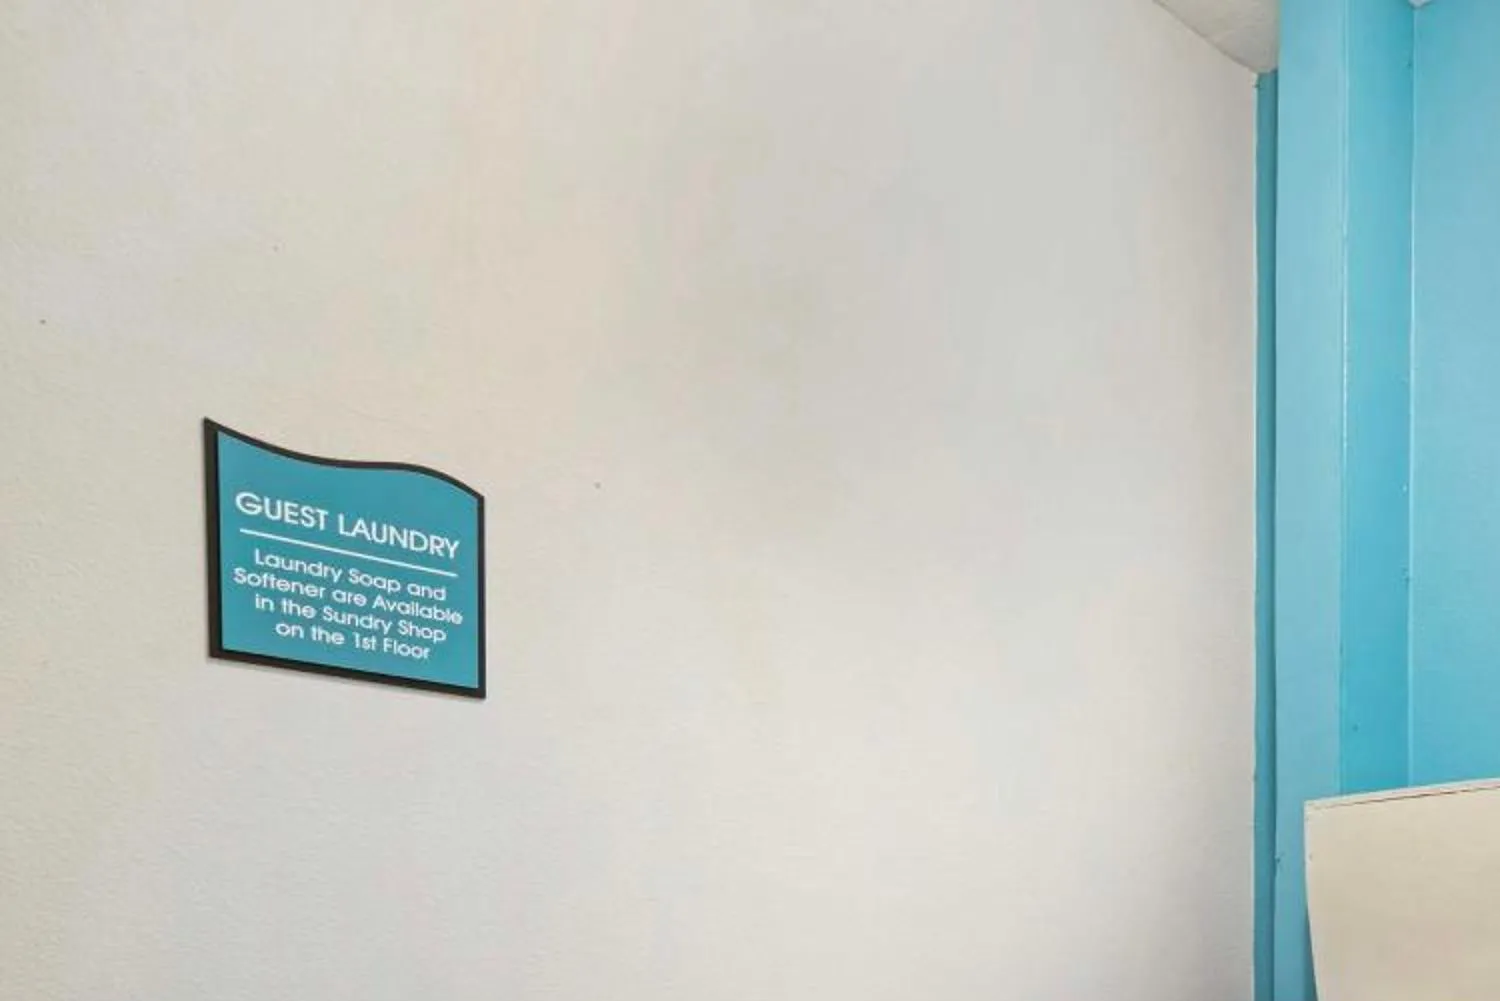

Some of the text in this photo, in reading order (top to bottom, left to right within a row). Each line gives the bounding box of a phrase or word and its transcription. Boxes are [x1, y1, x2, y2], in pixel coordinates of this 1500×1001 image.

[235, 491, 460, 559] GUEST LAUNDRY
[232, 567, 463, 624] Softener are Available
[255, 548, 447, 601] Laundry Soap and
[255, 593, 447, 643] in the Sundry Shop
[275, 622, 431, 659] on the 1st Floor
